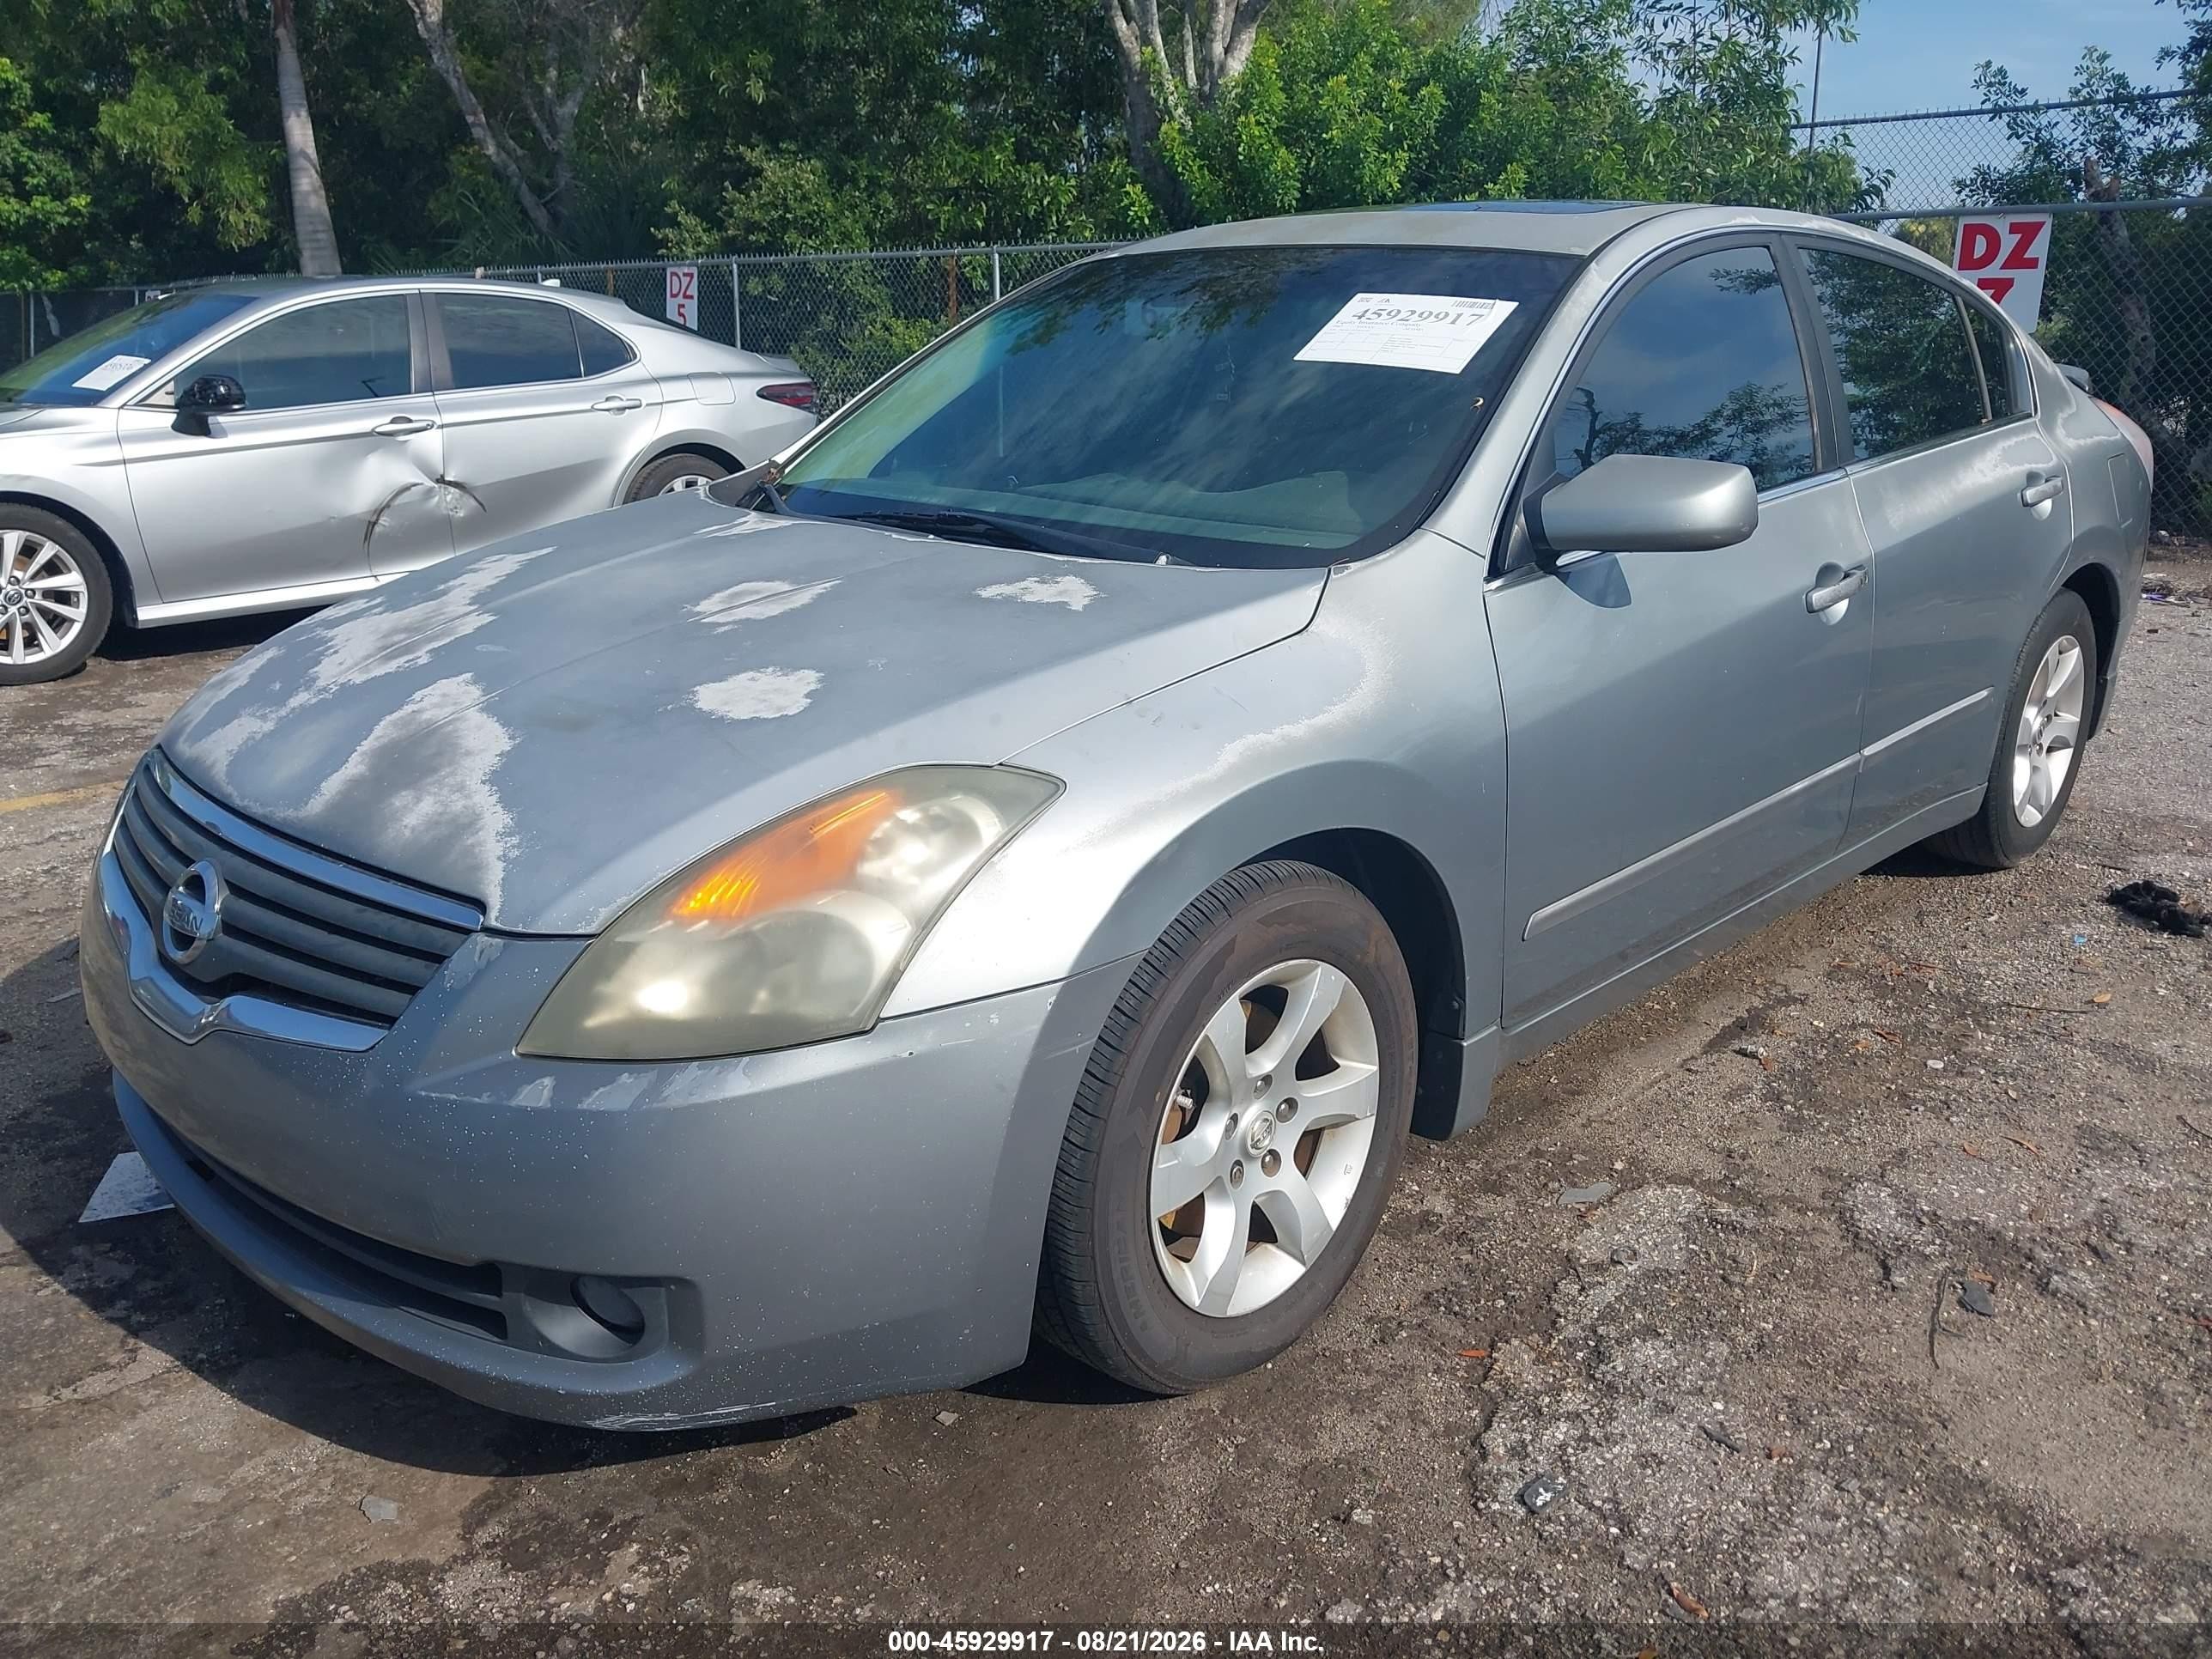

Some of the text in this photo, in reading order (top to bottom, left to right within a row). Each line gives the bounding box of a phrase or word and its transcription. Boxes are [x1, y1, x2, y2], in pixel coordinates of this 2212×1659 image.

[1958, 221, 2046, 271] DZ
[670, 270, 694, 300] DZ
[678, 303, 686, 325] 5
[1352, 308, 1486, 327] 45929917
